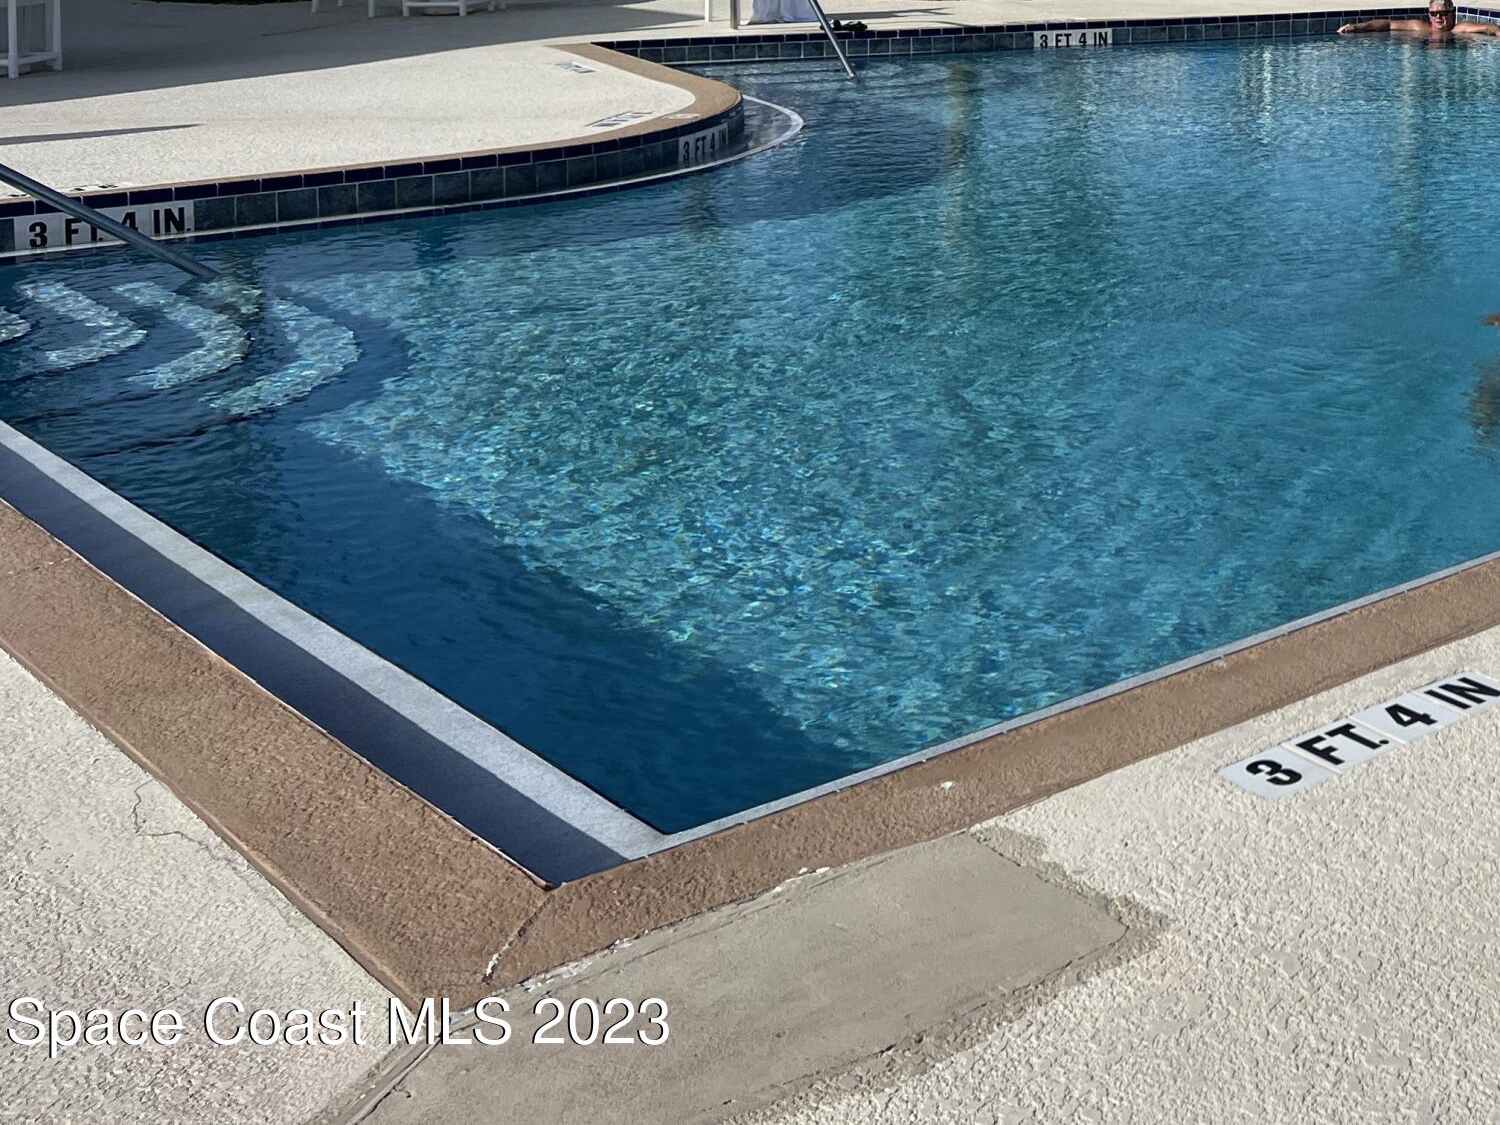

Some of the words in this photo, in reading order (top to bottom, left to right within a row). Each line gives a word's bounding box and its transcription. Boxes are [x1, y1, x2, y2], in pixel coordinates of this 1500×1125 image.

[1040, 34, 1048, 48] 3
[1055, 33, 1072, 47] FT
[1079, 32, 1087, 46] 4
[1093, 31, 1108, 46] IN
[683, 140, 690, 162] 3
[28, 221, 48, 248] 3
[153, 206, 192, 237] IN.
[1245, 759, 1303, 786] 3
[1295, 723, 1390, 766] FT.
[1384, 703, 1438, 727] 4
